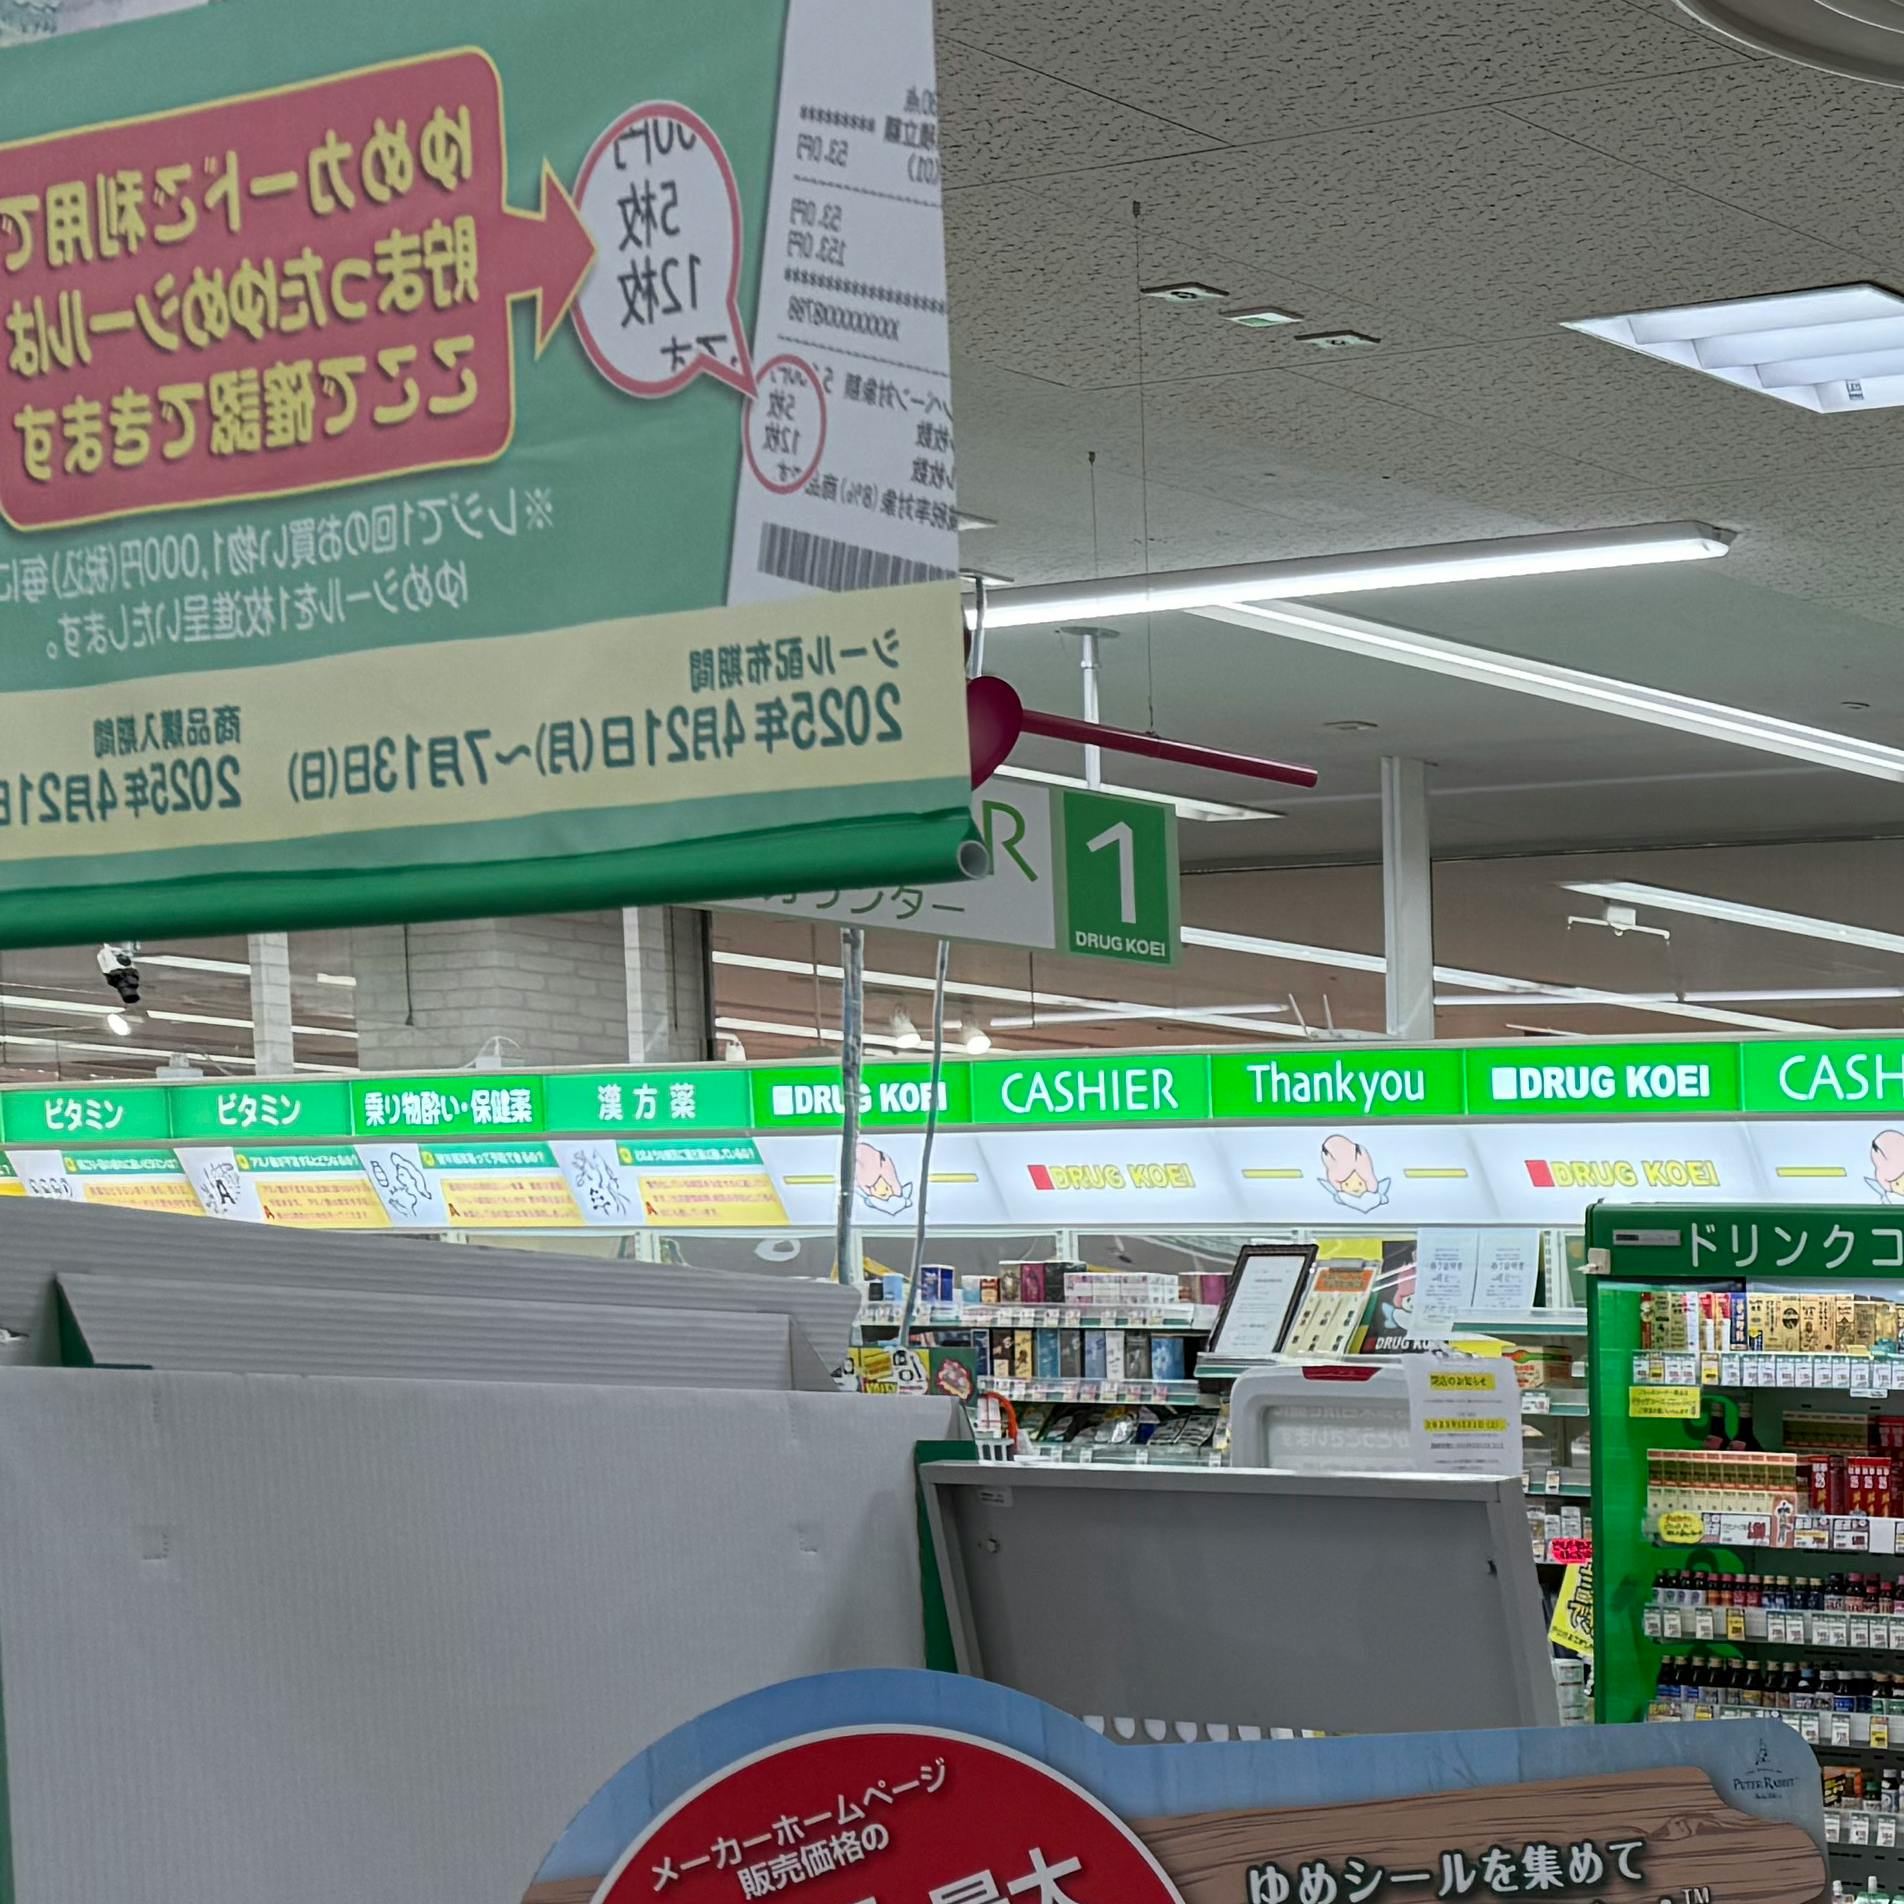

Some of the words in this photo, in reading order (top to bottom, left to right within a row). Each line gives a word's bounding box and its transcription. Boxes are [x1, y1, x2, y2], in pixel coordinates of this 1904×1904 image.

[1075, 930, 1124, 953] DRUG
[1125, 935, 1166, 959] KOEI
[795, 1081, 873, 1115] DRUG
[878, 1080, 948, 1114] KOEI
[1001, 1064, 1179, 1115] CASHIER
[1518, 1065, 1623, 1100] DRUG
[1626, 1065, 1711, 1099] KOEI
[43, 1097, 126, 1132] ビタミン
[216, 1093, 303, 1128] ビタミン
[595, 1082, 697, 1121] 漢方薬
[1050, 1163, 1126, 1191] DRUG
[1130, 1163, 1194, 1191] KOEI
[1551, 1158, 1639, 1188] DRUG
[1641, 1159, 1719, 1188] KOEI
[1374, 1336, 1410, 1350] DRUG
[650, 1756, 949, 1893] メーカーホームページ
[738, 1823, 893, 1902] 販売価格の
